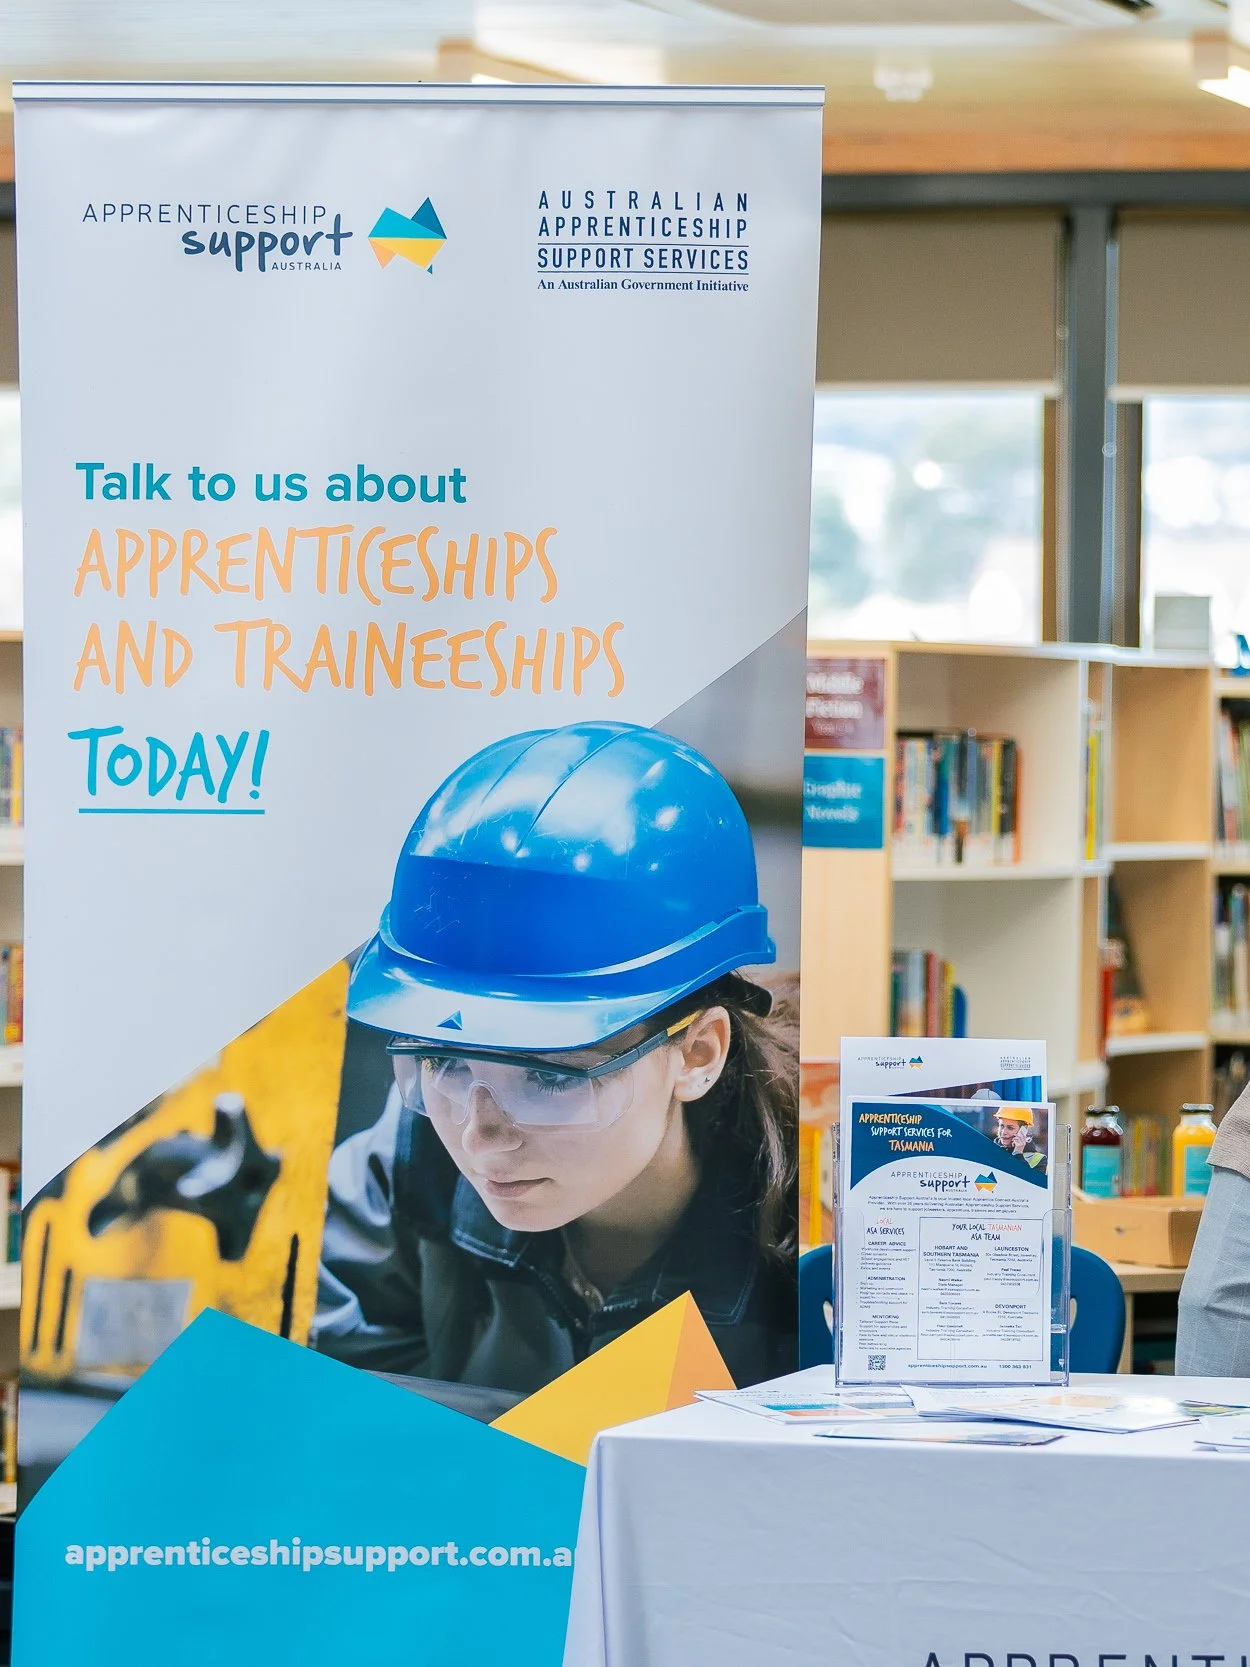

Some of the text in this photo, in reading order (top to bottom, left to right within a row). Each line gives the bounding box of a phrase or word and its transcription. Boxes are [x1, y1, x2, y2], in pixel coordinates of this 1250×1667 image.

[538, 190, 748, 212] AUSTRALIAN
[82, 203, 327, 225] APPRENTICESHIP
[538, 216, 748, 239] APPRENTICESHIP
[181, 213, 354, 273] support
[271, 261, 343, 271] AUSTRALIA
[537, 247, 749, 270] SUPPORT SERVICES
[537, 278, 749, 292] An Australian Government Initiative
[76, 462, 467, 503] Talk to us about
[73, 524, 559, 606] APPRENTICESHIPS
[73, 617, 625, 697] AND TRAINEESHIPS
[67, 725, 270, 803] TODAY!
[875, 1059, 906, 1069] support
[859, 1113, 922, 1125] APPRENTICESHIP
[871, 1126, 952, 1138] SUPPORT SERVICES FOR
[889, 1140, 934, 1152] TASMANIA
[890, 1171, 963, 1179] APPRENTICESHIP
[920, 1176, 970, 1192] support
[866, 1227, 904, 1235] ASA SERVICES
[952, 1223, 1022, 1232] YOUR LOCAL TASMANIAN
